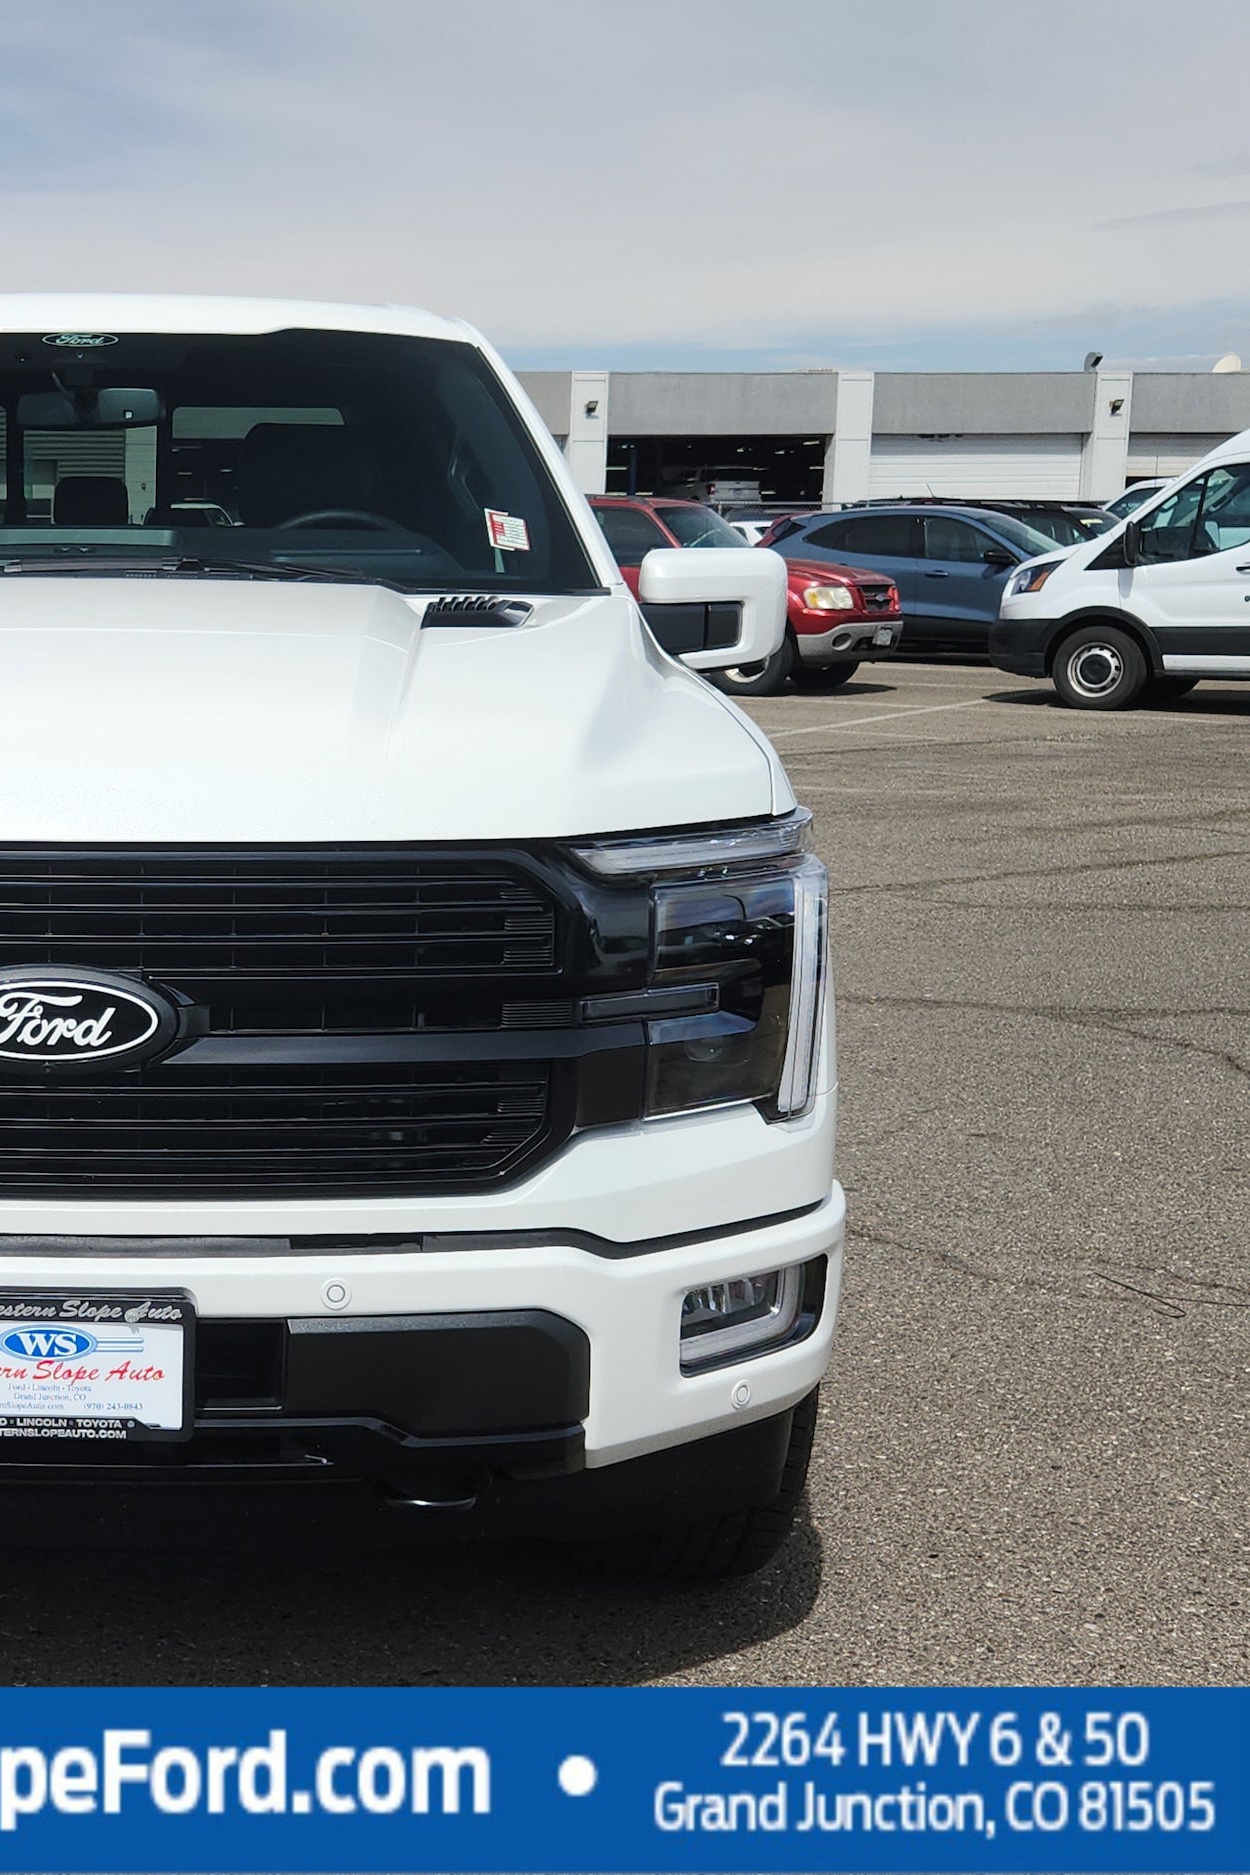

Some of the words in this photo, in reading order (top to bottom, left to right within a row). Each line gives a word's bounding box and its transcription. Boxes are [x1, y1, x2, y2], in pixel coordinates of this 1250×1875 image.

[56, 334, 105, 344] Ford
[59, 1300, 123, 1322] Slope
[125, 1301, 183, 1320] Auto
[16, 1332, 78, 1356] WS
[32, 1360, 100, 1385] Slope
[104, 1360, 165, 1382] Auto
[32, 1384, 61, 1392] Lincoln
[67, 1385, 92, 1394] Toyota
[16, 1418, 68, 1428] LINCOLN
[75, 1419, 122, 1429] TOYOTA
